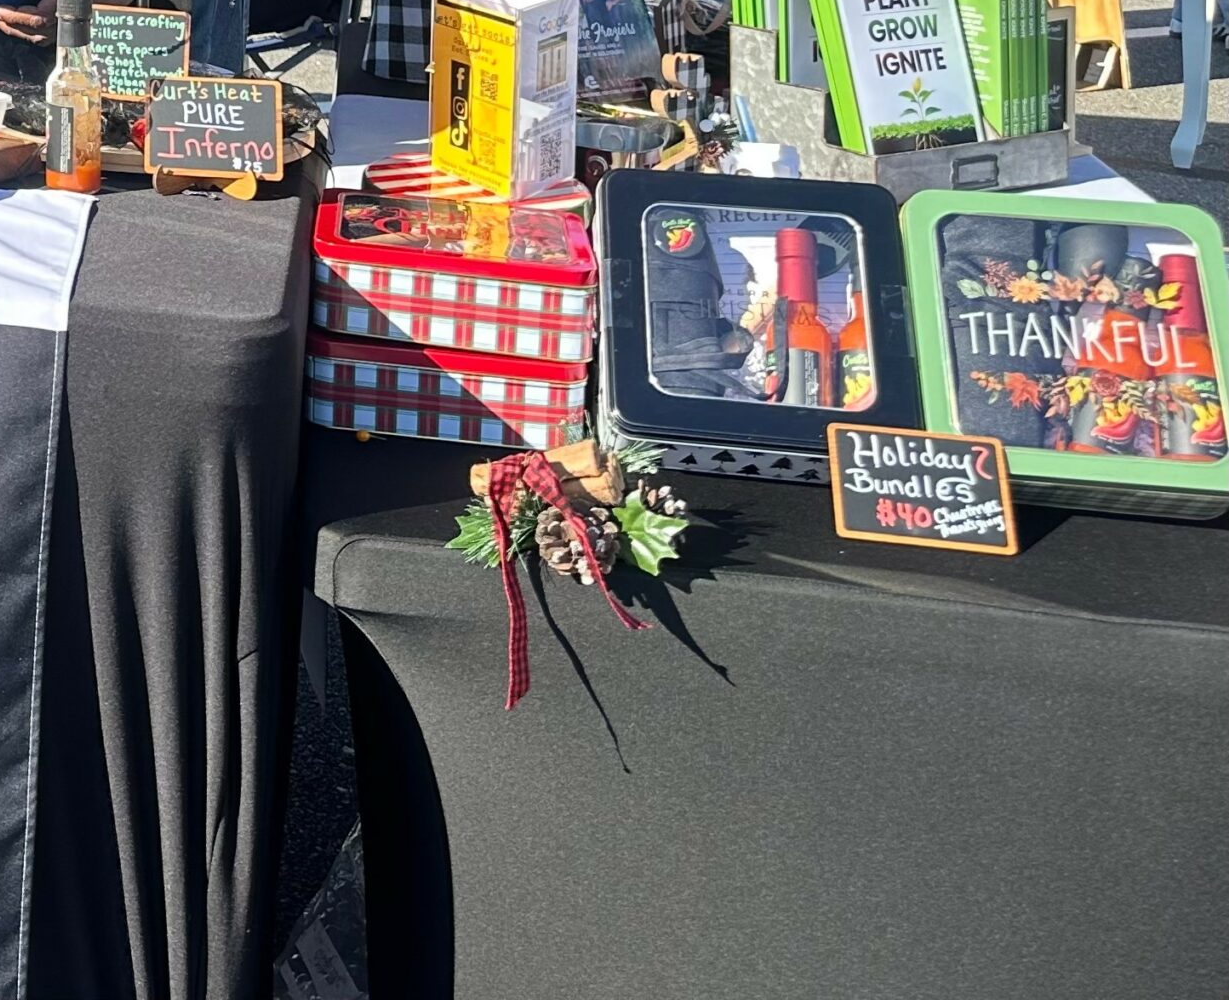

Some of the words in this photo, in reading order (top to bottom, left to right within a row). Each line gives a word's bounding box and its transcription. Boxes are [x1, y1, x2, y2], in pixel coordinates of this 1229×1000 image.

[95, 10, 134, 26] hours
[539, 14, 568, 34] Google
[868, 14, 938, 42] GROW
[577, 27, 591, 39] he
[590, 22, 636, 43] Fraziers
[876, 47, 947, 76] IGNITE
[150, 80, 209, 101] Curt's
[214, 82, 263, 103] Heat
[183, 102, 244, 125] PURE
[156, 127, 274, 160] Inferno
[232, 157, 263, 173] $25
[959, 311, 1196, 369] THANKFUL
[847, 432, 976, 485] Holiday
[844, 468, 976, 503] Bundles
[876, 498, 932, 530] $40
